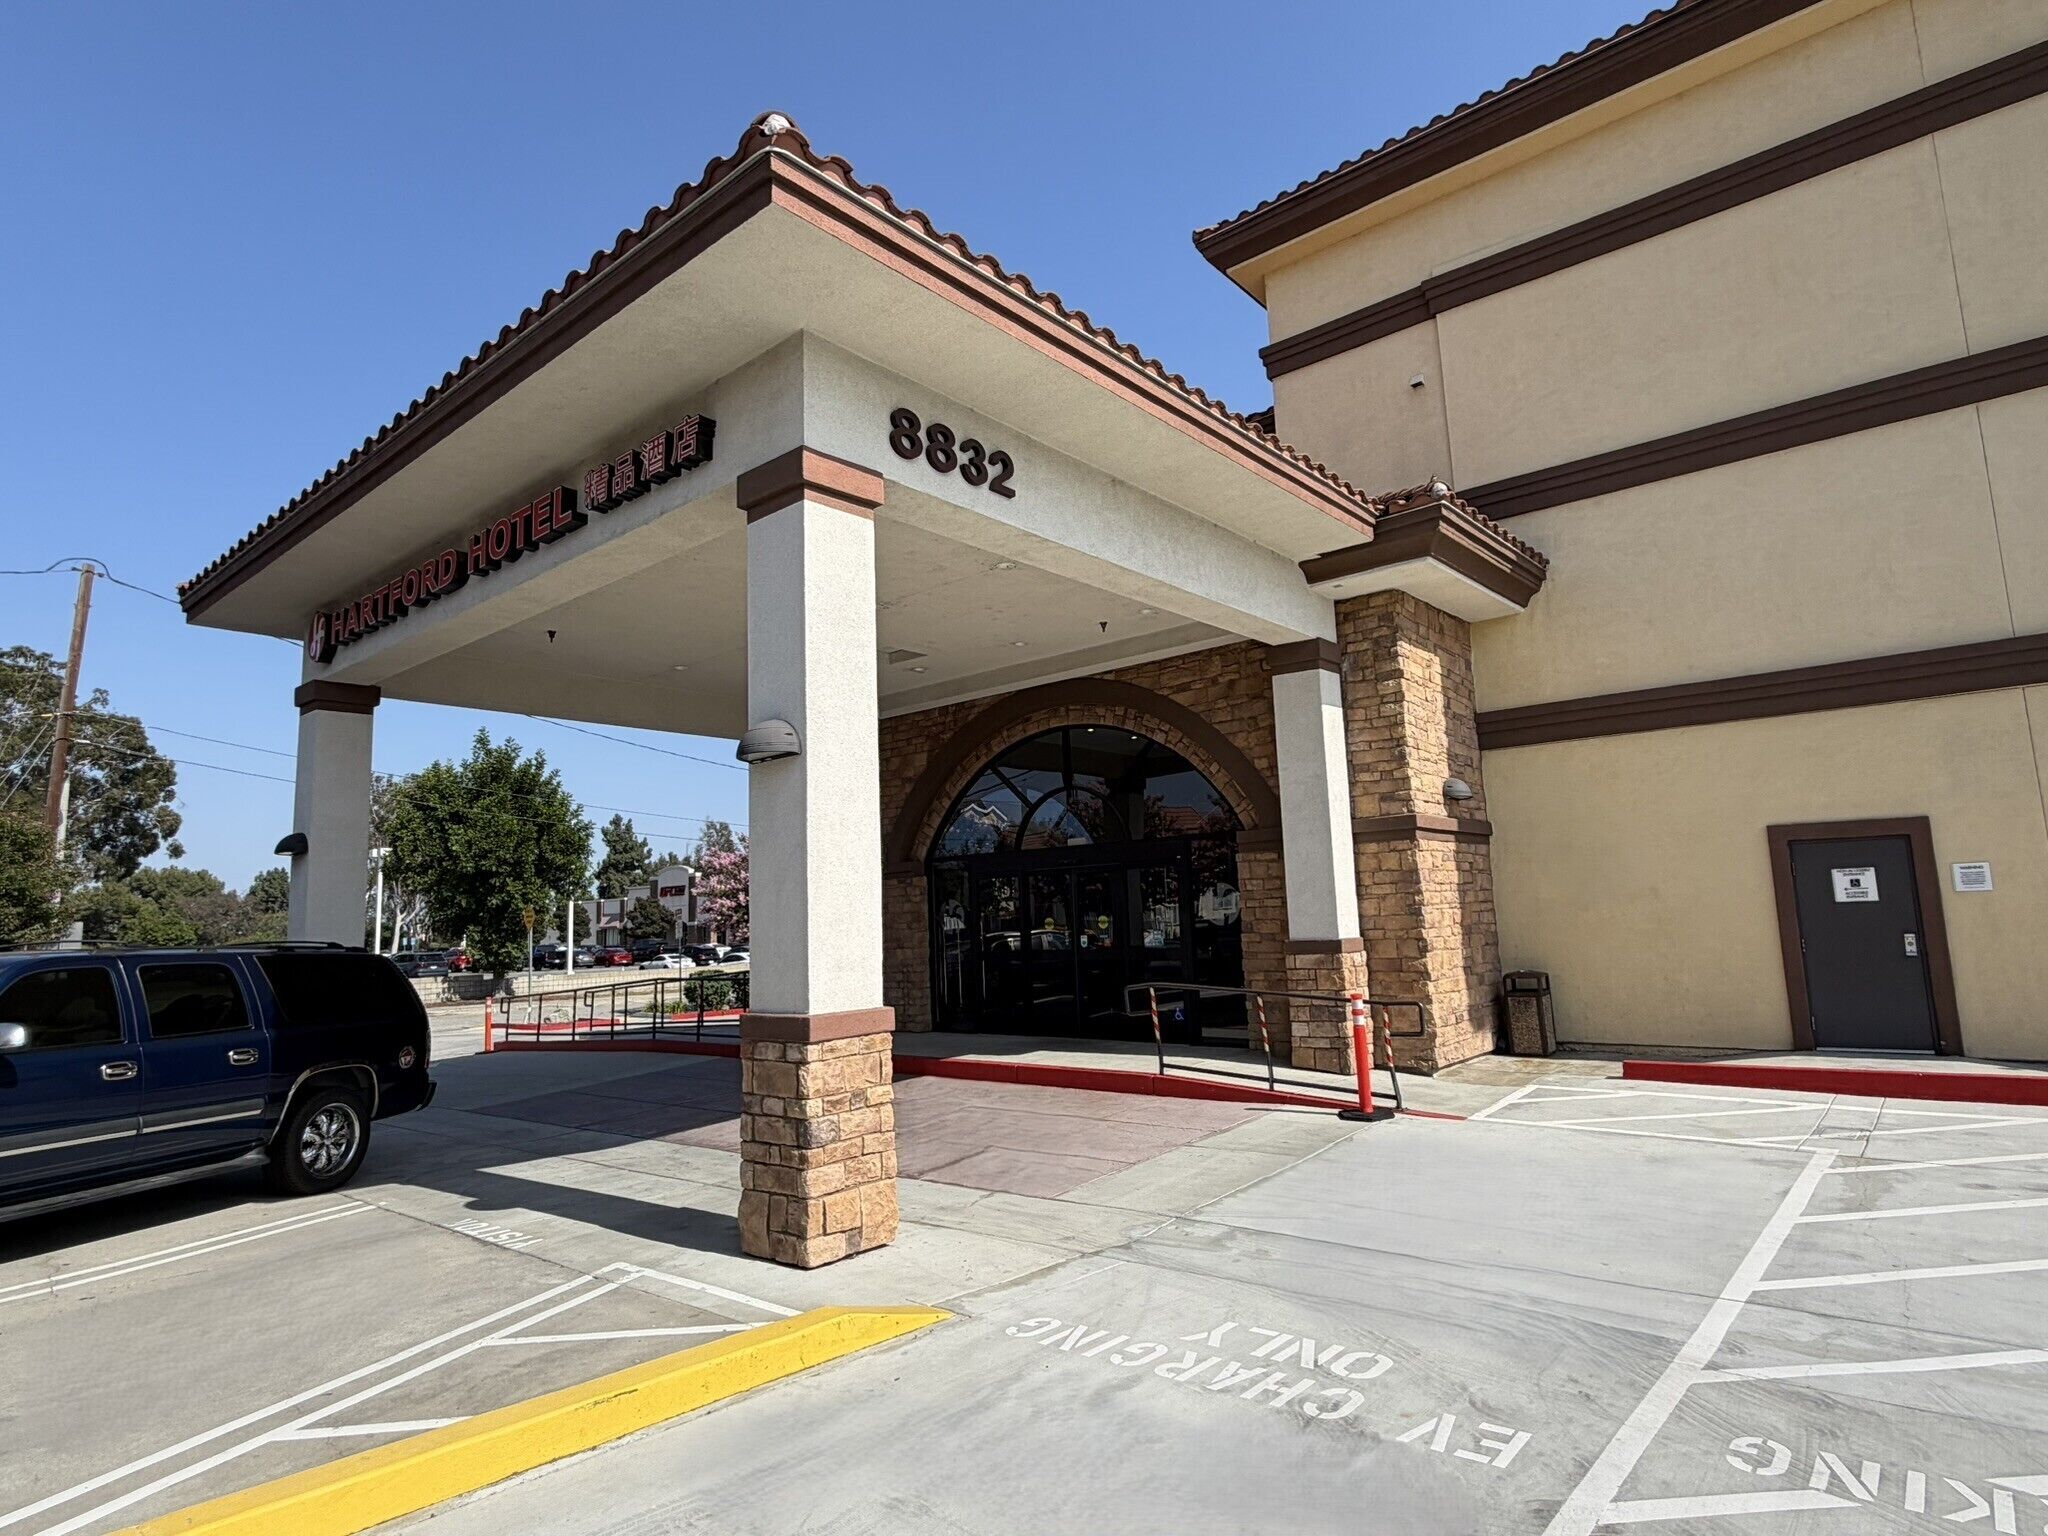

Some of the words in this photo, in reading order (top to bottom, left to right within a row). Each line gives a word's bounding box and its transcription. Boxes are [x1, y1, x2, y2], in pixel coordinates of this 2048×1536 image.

[584, 414, 701, 509] 精品酒店
[889, 407, 1016, 499] 8832
[331, 548, 459, 645] HARTFORD
[467, 486, 575, 575] HOTEL
[1005, 1317, 1365, 1420] CHARGING
[1180, 1321, 1394, 1379] ONLY
[1396, 1413, 1533, 1468] EV
[1726, 1436, 2048, 1536] KING
